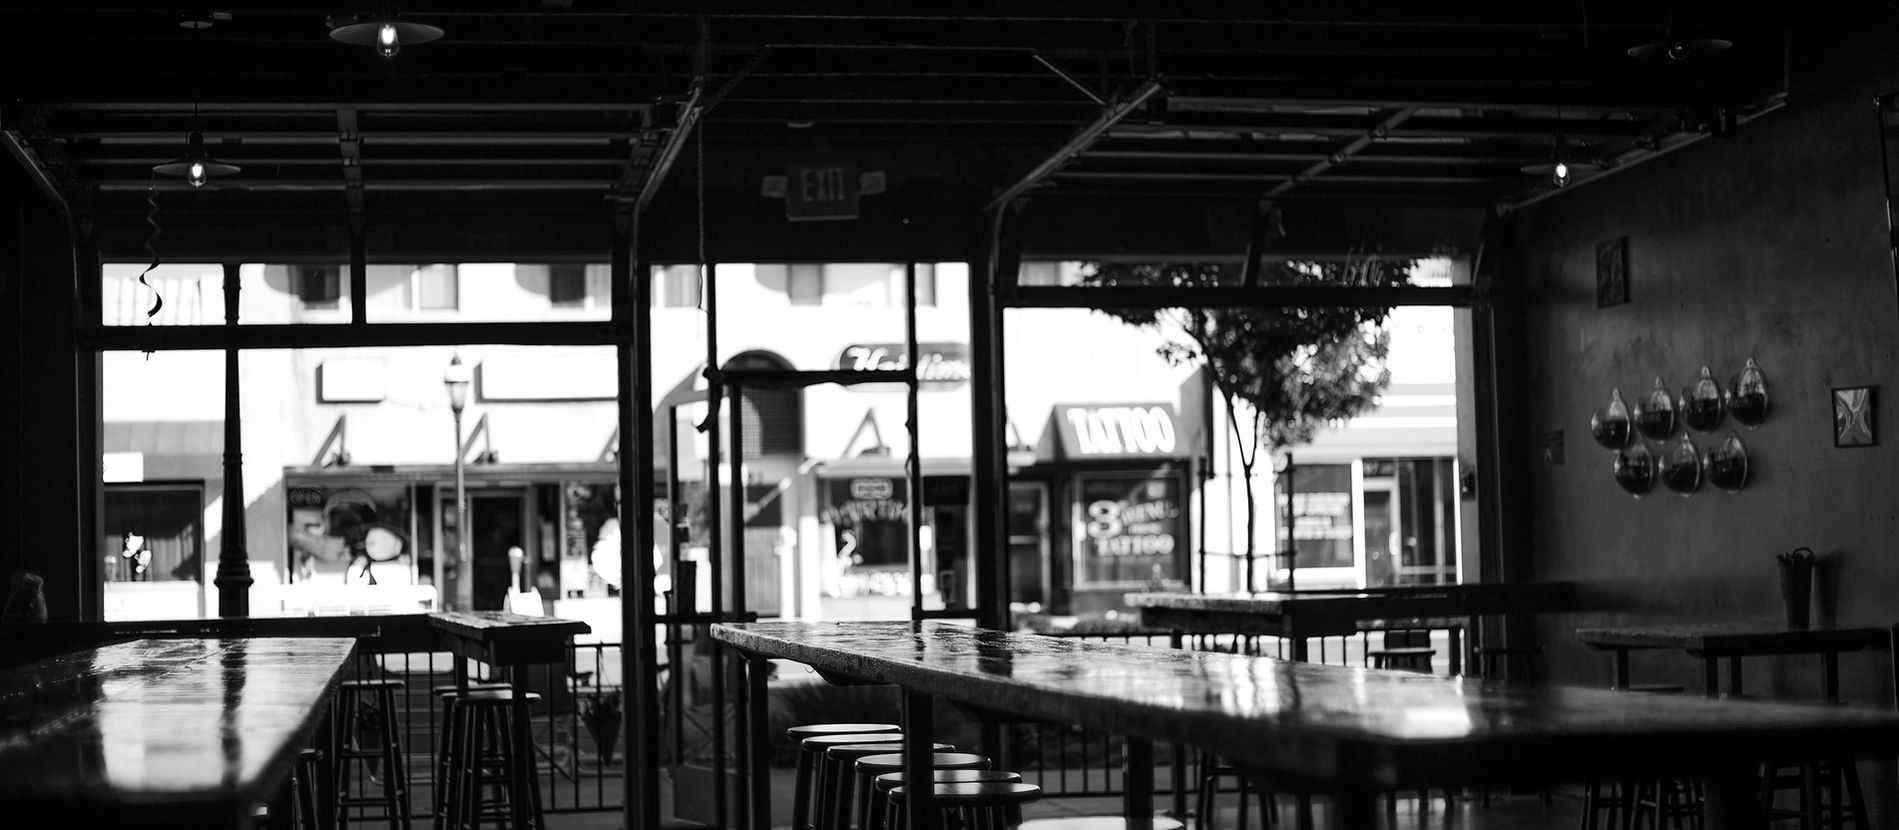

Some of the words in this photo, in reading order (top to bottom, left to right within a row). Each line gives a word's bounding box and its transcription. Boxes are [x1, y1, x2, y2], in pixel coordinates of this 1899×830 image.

[802, 167, 846, 202] EXIT
[1067, 406, 1176, 454] TATTOO
[1094, 533, 1176, 556] TATTOO
